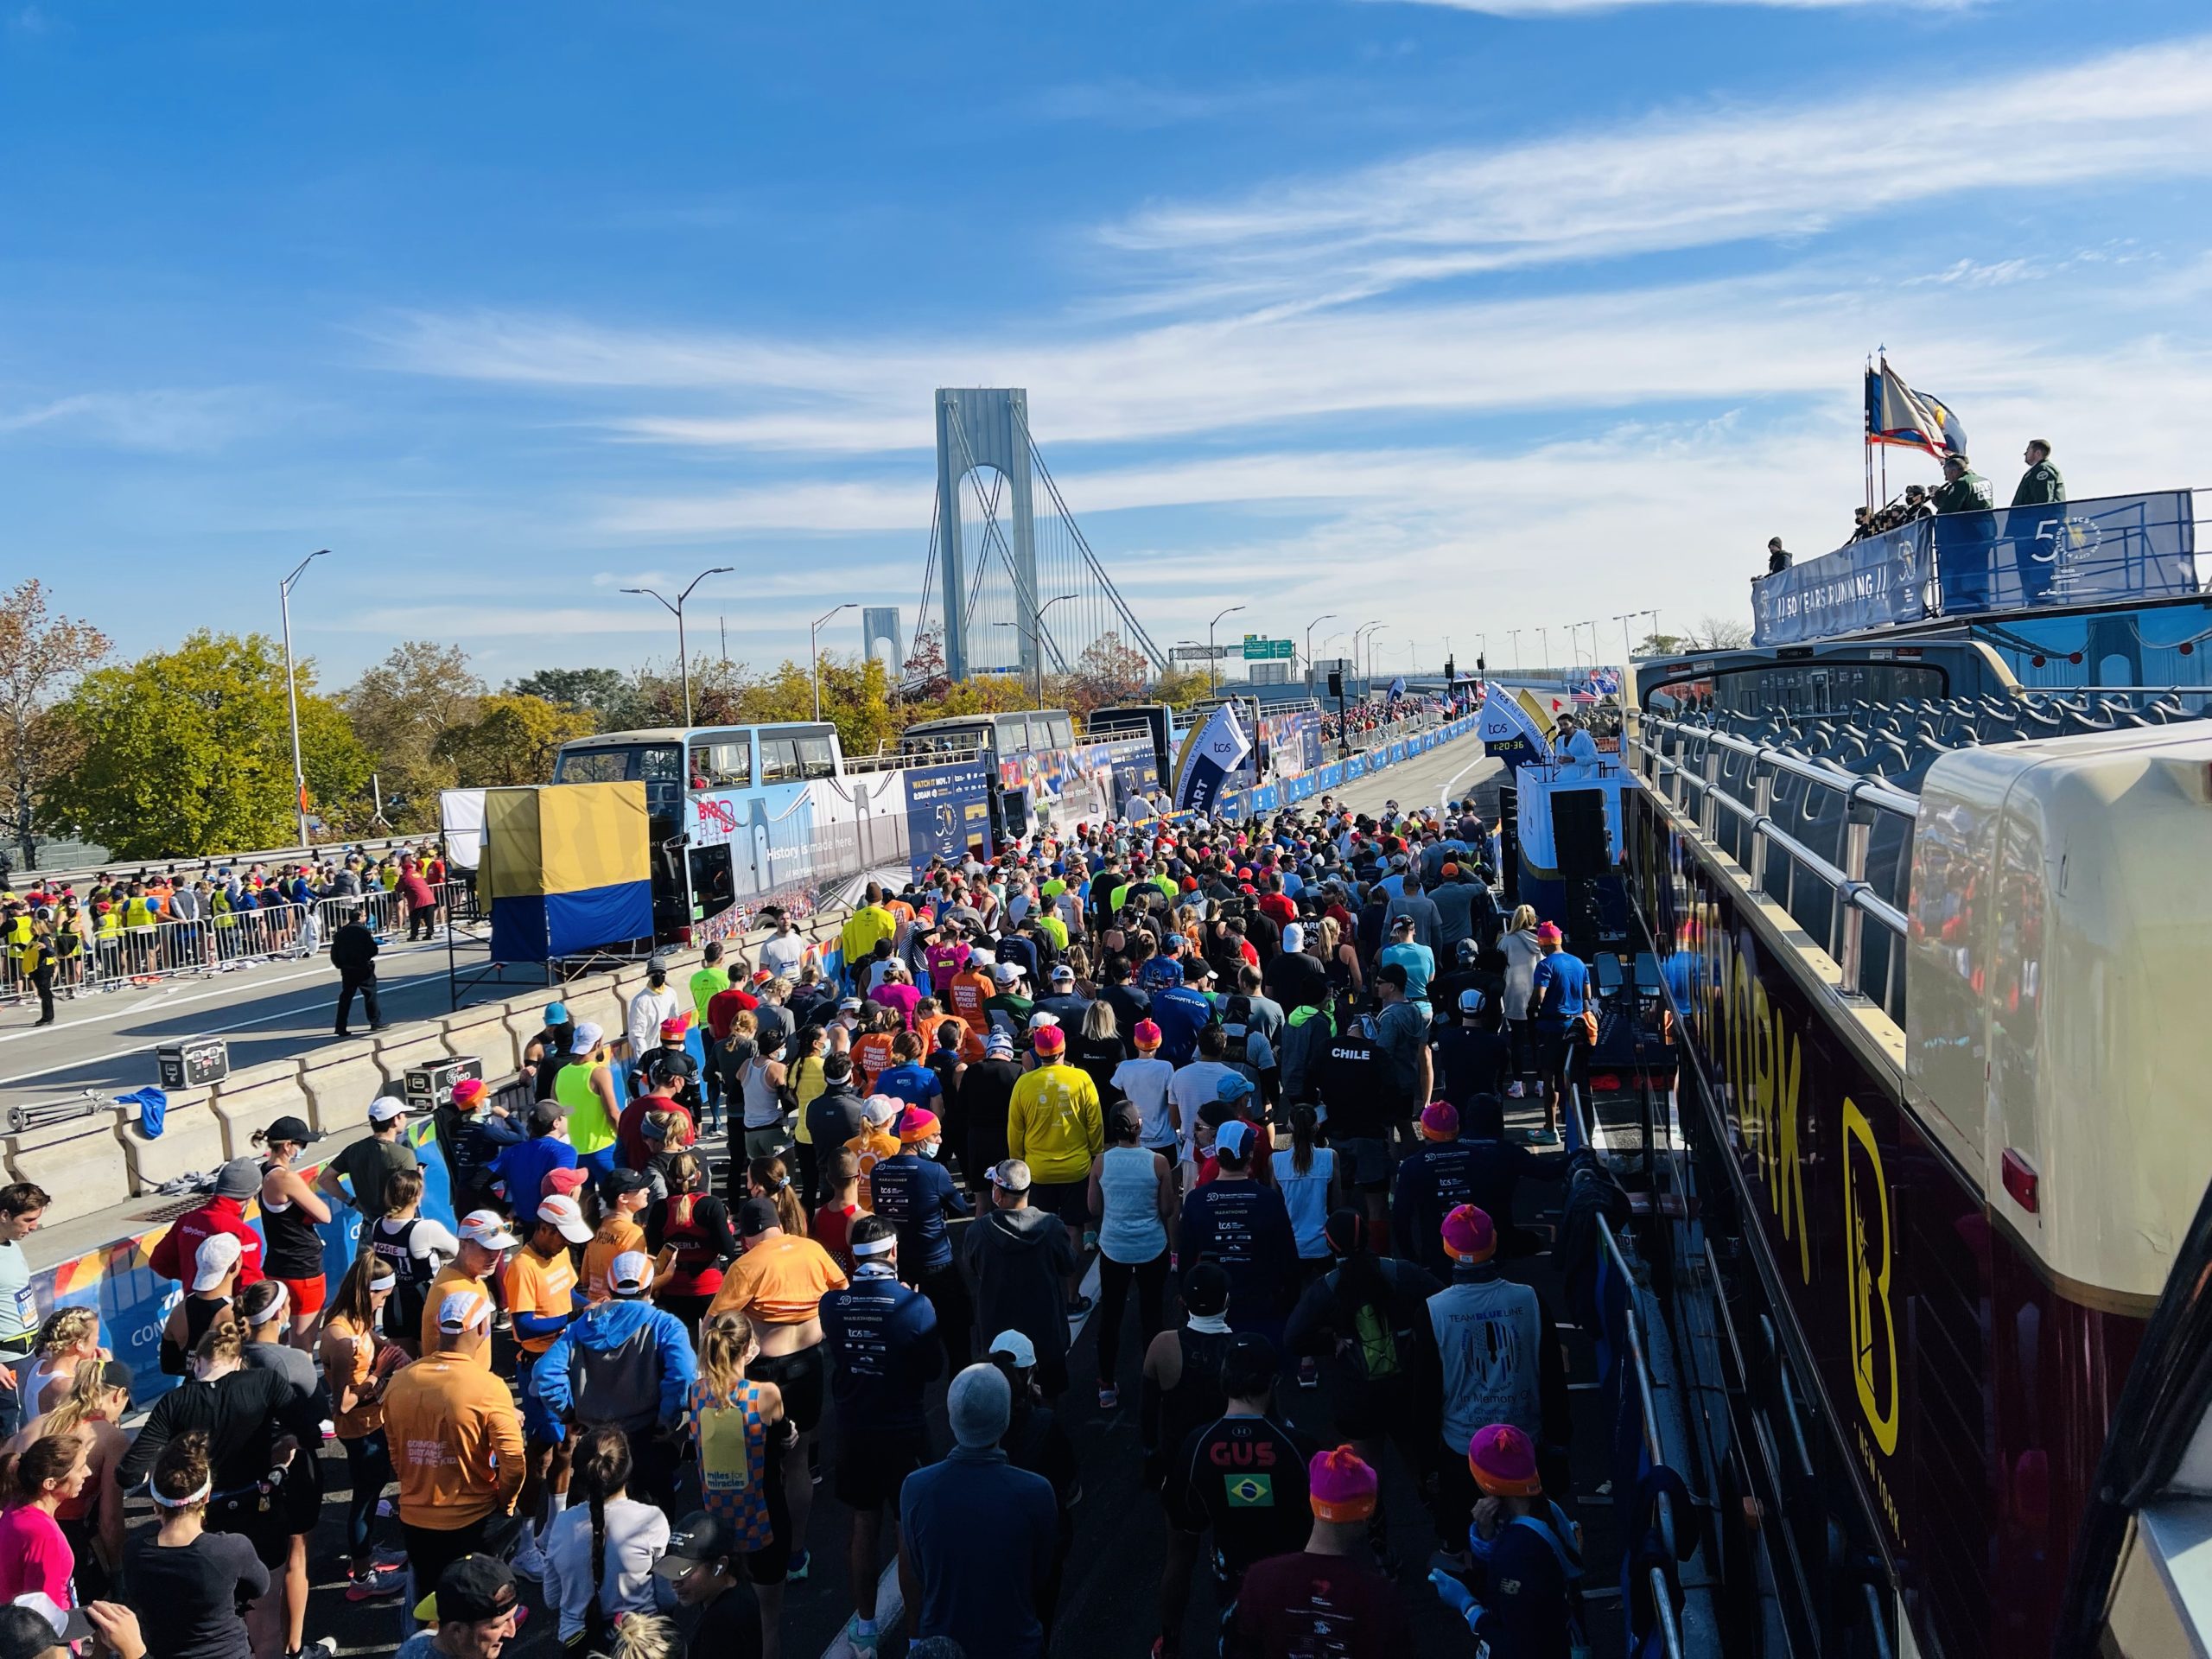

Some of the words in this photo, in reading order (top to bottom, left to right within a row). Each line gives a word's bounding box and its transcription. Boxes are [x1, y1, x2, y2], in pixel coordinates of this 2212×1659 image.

[1788, 596, 1797, 618] 50
[1496, 690, 1510, 704] TCS
[1510, 702, 1525, 719] NEW
[1488, 722, 1507, 734] tcs
[1180, 772, 1189, 791] YORK
[1186, 753, 1196, 771] CITY
[1193, 713, 1222, 753] MARATHON
[1214, 741, 1231, 753] tcs
[766, 844, 798, 864] History
[800, 842, 809, 855] is
[810, 838, 833, 853] made
[835, 836, 855, 850] here.
[1332, 1047, 1370, 1060] CHILE
[880, 1185, 892, 1194] tcs
[1218, 1221, 1231, 1230] tcs
[376, 1244, 398, 1255] JOSIE
[848, 1328, 862, 1338] tcs
[1473, 1394, 1516, 1404] Memory
[409, 1448, 442, 1459] DISTACE
[1210, 1441, 1276, 1466] GUS
[708, 1471, 729, 1479] miles
[731, 1471, 743, 1479] for
[1859, 1426, 1876, 1482] NEW
[1878, 1469, 1900, 1541] YORK
